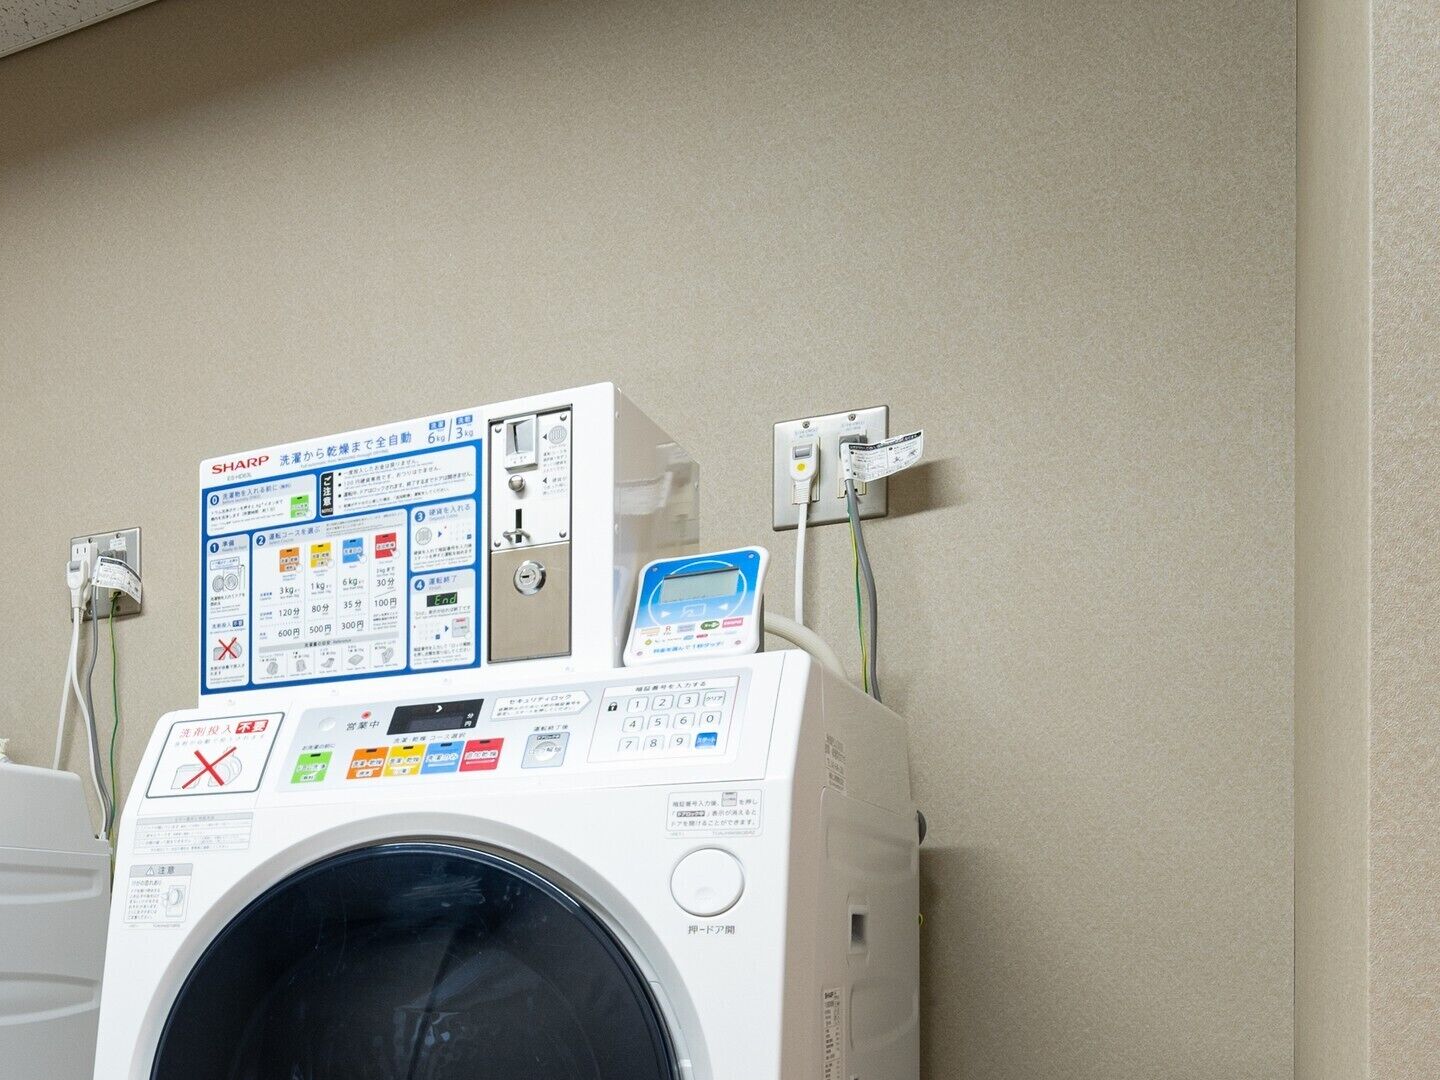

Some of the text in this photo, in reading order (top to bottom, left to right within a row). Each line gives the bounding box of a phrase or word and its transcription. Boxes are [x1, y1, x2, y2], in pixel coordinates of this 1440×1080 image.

[280, 431, 412, 467] 洗濯から乾燥まで全自動
[211, 455, 269, 475] SHARP
[429, 503, 470, 517] 硬貨を入れる
[377, 578, 395, 587] 30分
[429, 575, 457, 585] 運転終了
[343, 600, 362, 609] 35分
[374, 598, 397, 607] 100円
[434, 594, 457, 606] End
[279, 608, 300, 616] 120分
[312, 604, 329, 613] 80分
[310, 624, 332, 633] 500円
[341, 620, 364, 630] 300円
[278, 628, 300, 637] 600円
[635, 681, 706, 692] 暗証番号を入力する
[510, 695, 572, 704] セキュリティロック
[346, 720, 380, 731] 営業中
[655, 718, 661, 726] 5
[706, 715, 714, 723] 0
[180, 724, 232, 738] 洗剤投入
[626, 741, 632, 749] 7
[650, 739, 657, 747] 8
